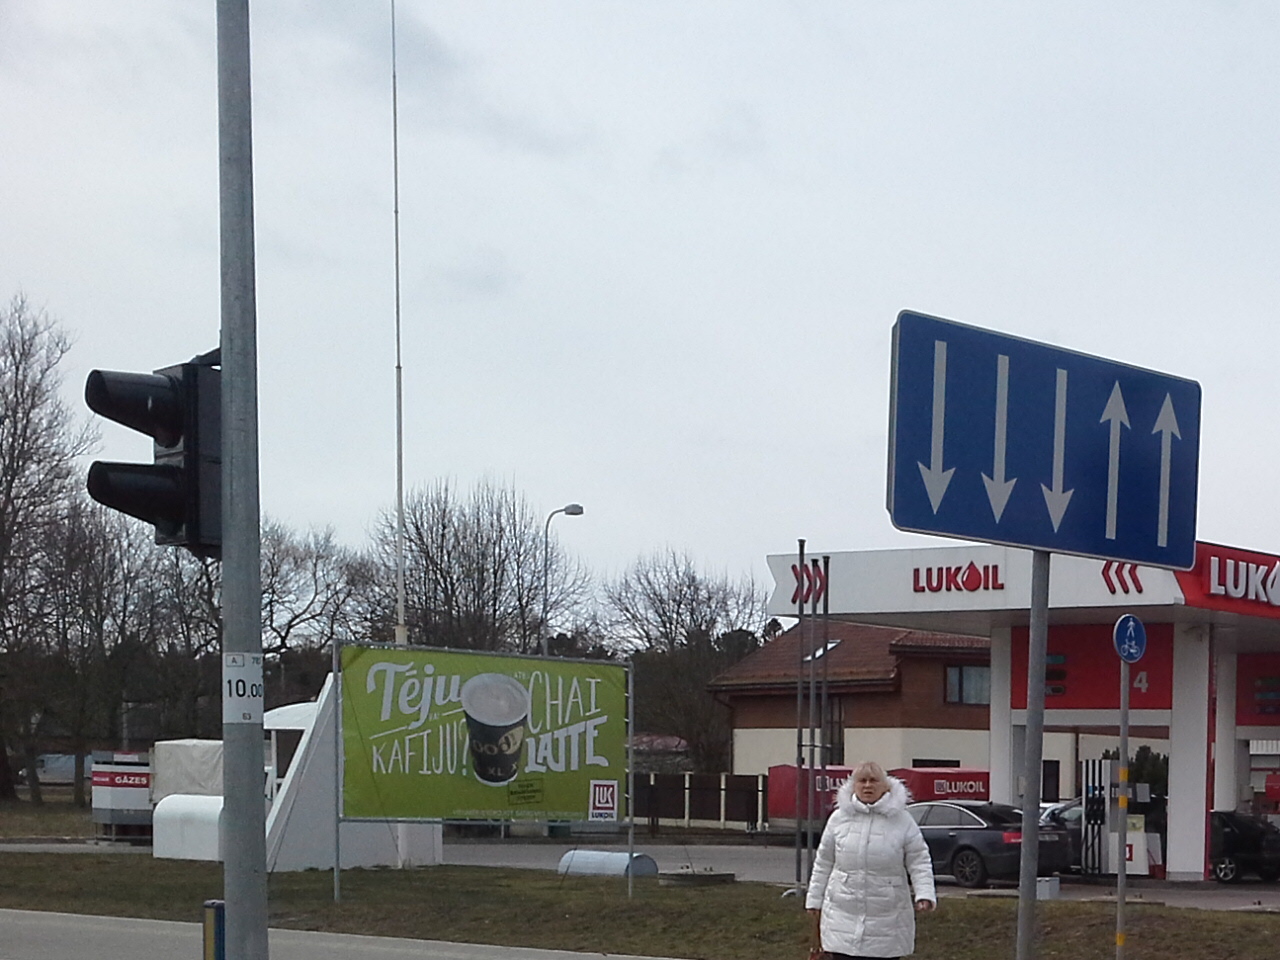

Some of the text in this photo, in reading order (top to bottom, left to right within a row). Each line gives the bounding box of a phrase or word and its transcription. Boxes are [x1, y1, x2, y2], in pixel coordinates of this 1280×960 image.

[913, 560, 1004, 592] LUKOIL
[227, 678, 264, 698] 10.00
[1133, 671, 1149, 693] 4
[527, 670, 601, 734] CHAI
[524, 715, 609, 774] LATTE
[945, 780, 986, 793] LUKOIL
